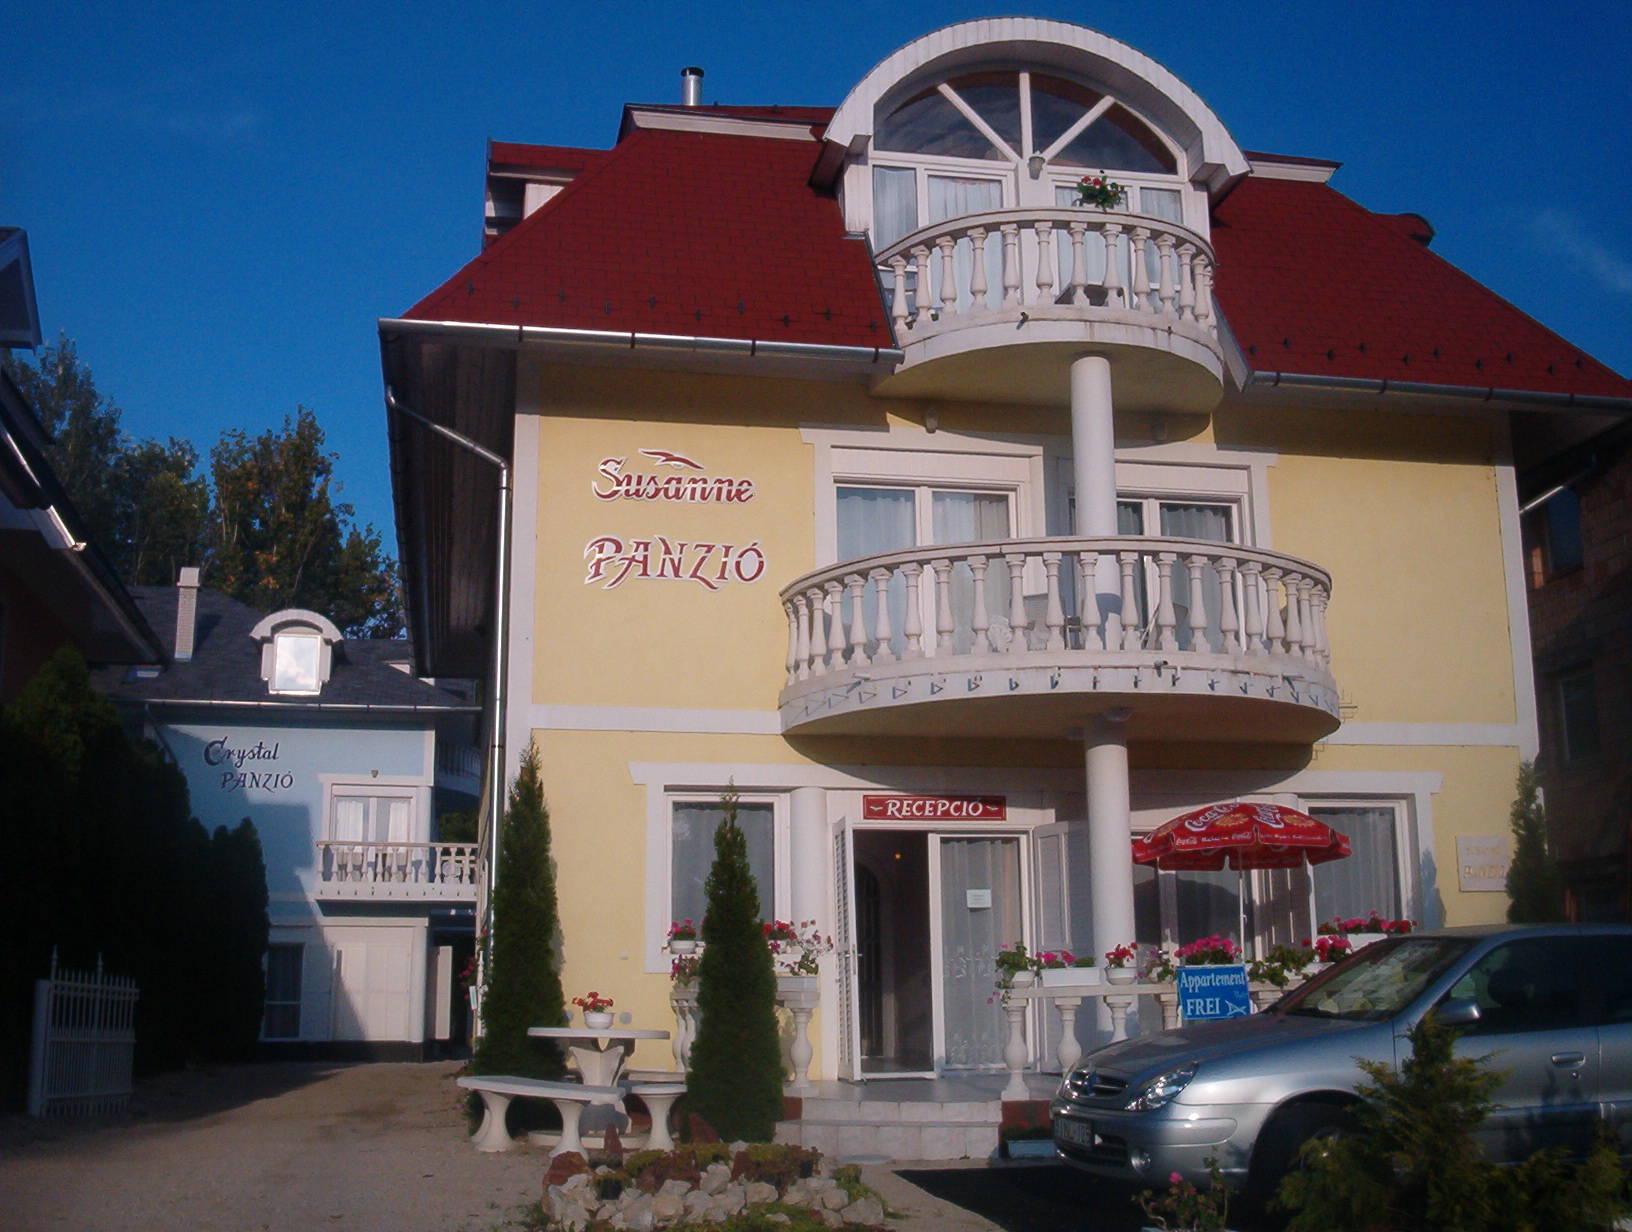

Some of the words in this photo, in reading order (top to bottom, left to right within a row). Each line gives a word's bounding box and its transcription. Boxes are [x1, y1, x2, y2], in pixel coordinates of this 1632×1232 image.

[592, 457, 755, 503] Susanne
[584, 535, 766, 590] PANZIÓ
[204, 736, 279, 768] Crystal
[221, 770, 294, 793] PANZIÓ
[1180, 972, 1245, 993] Appartement
[1186, 997, 1221, 1016] FREI
